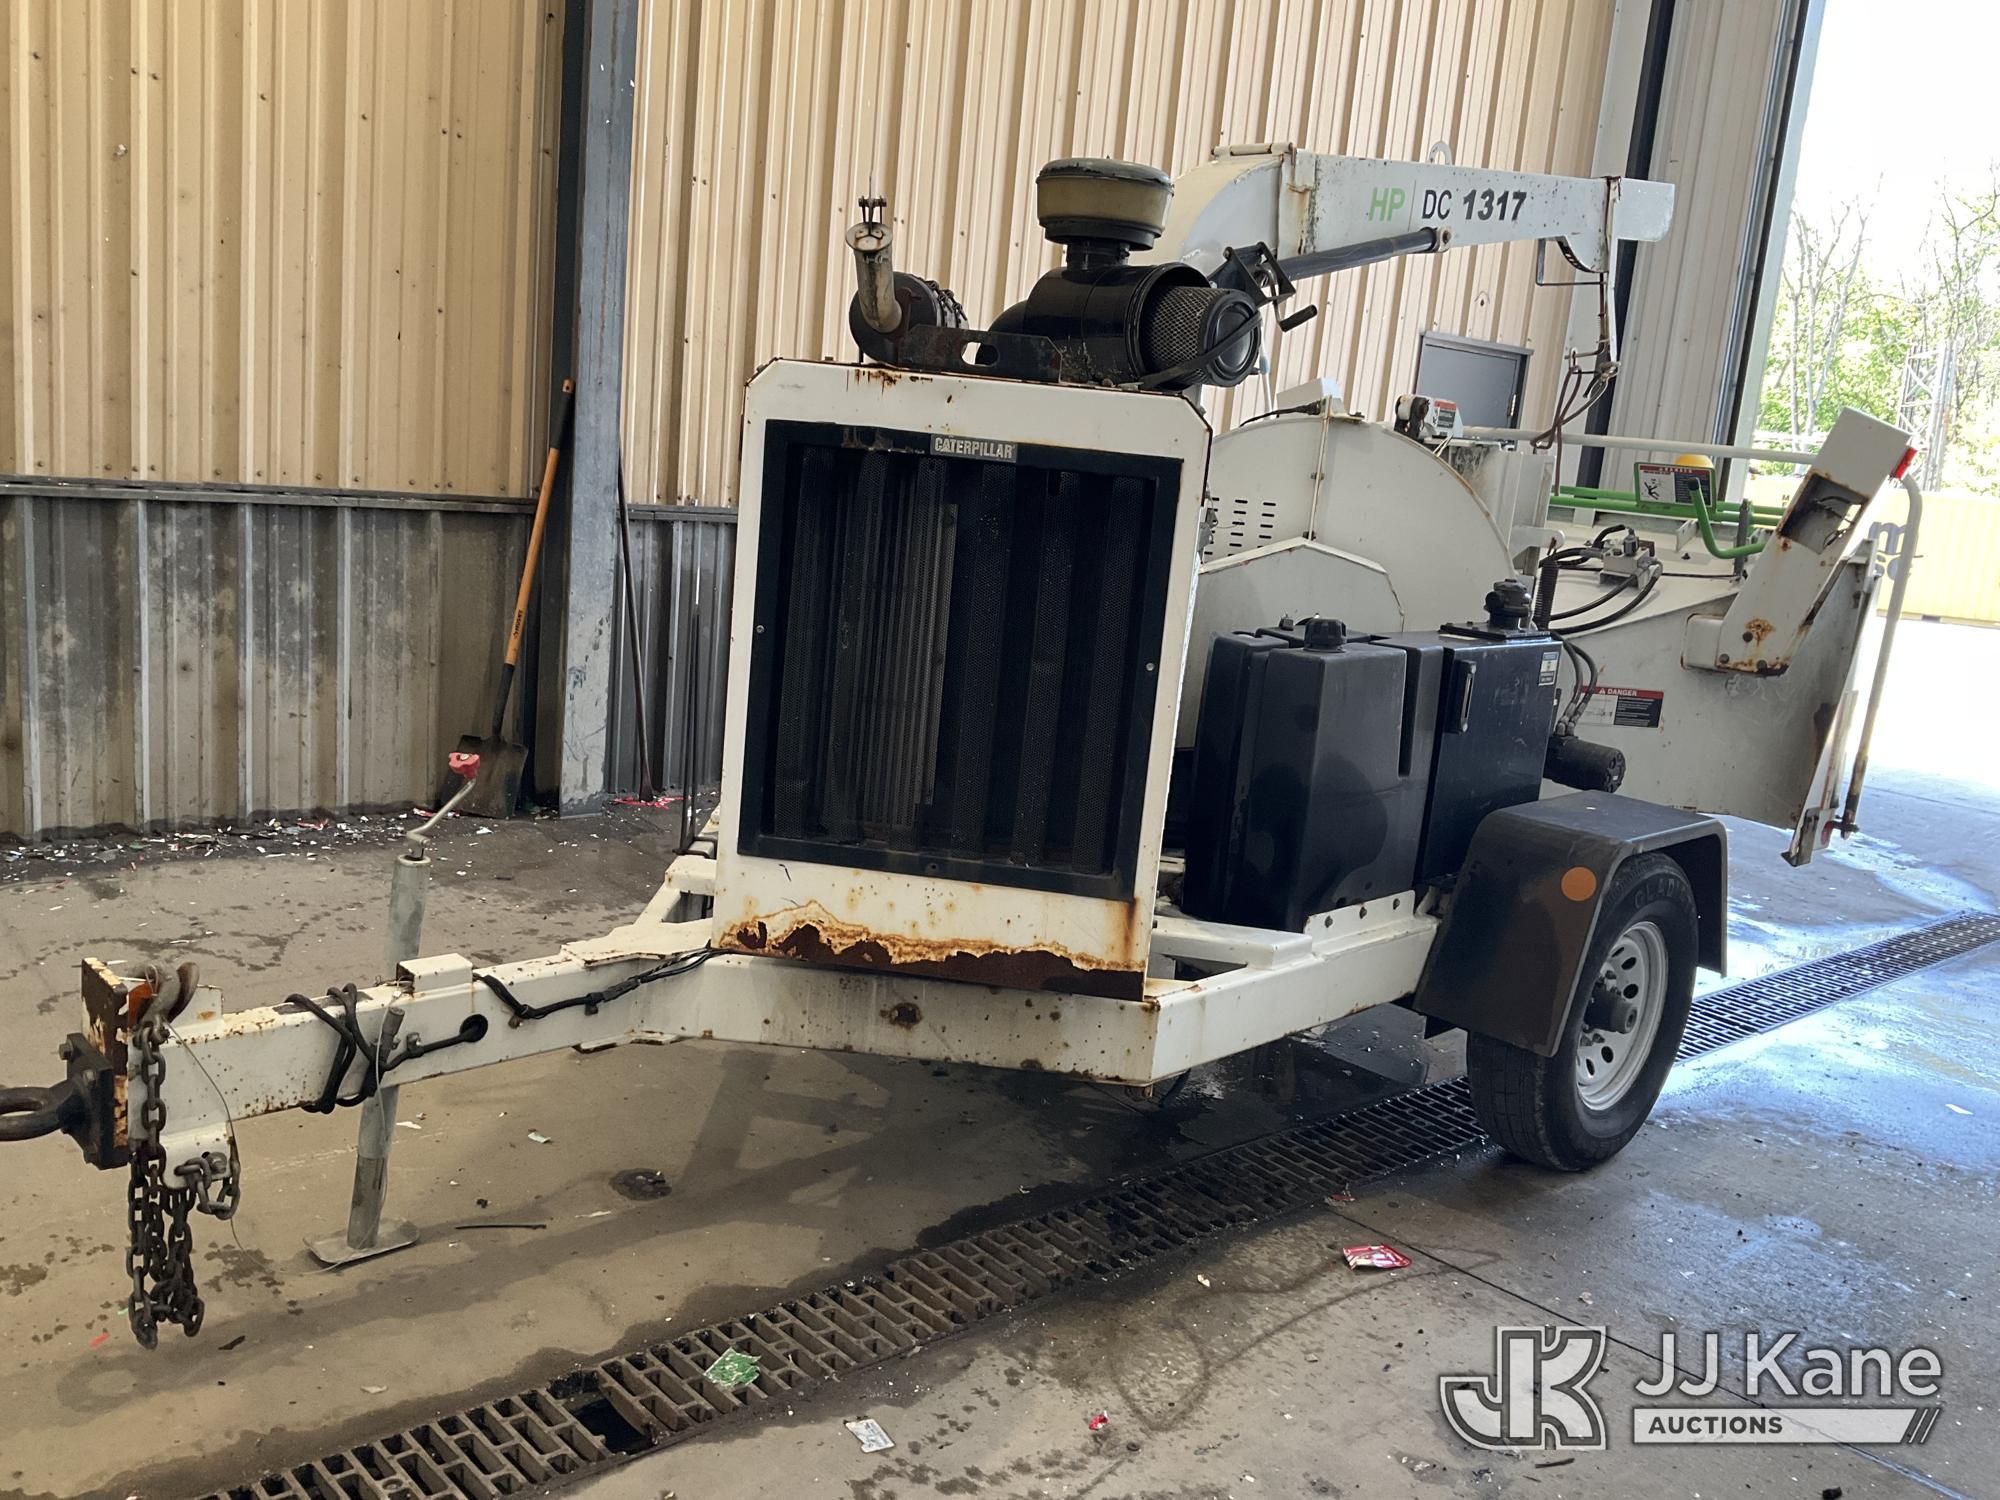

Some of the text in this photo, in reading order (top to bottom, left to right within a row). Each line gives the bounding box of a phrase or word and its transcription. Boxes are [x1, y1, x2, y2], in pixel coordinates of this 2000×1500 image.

[1368, 187, 1527, 222] HP DC 1317
[934, 437, 1013, 459] CATERPILLAR
[1607, 688, 1637, 697] DANGER
